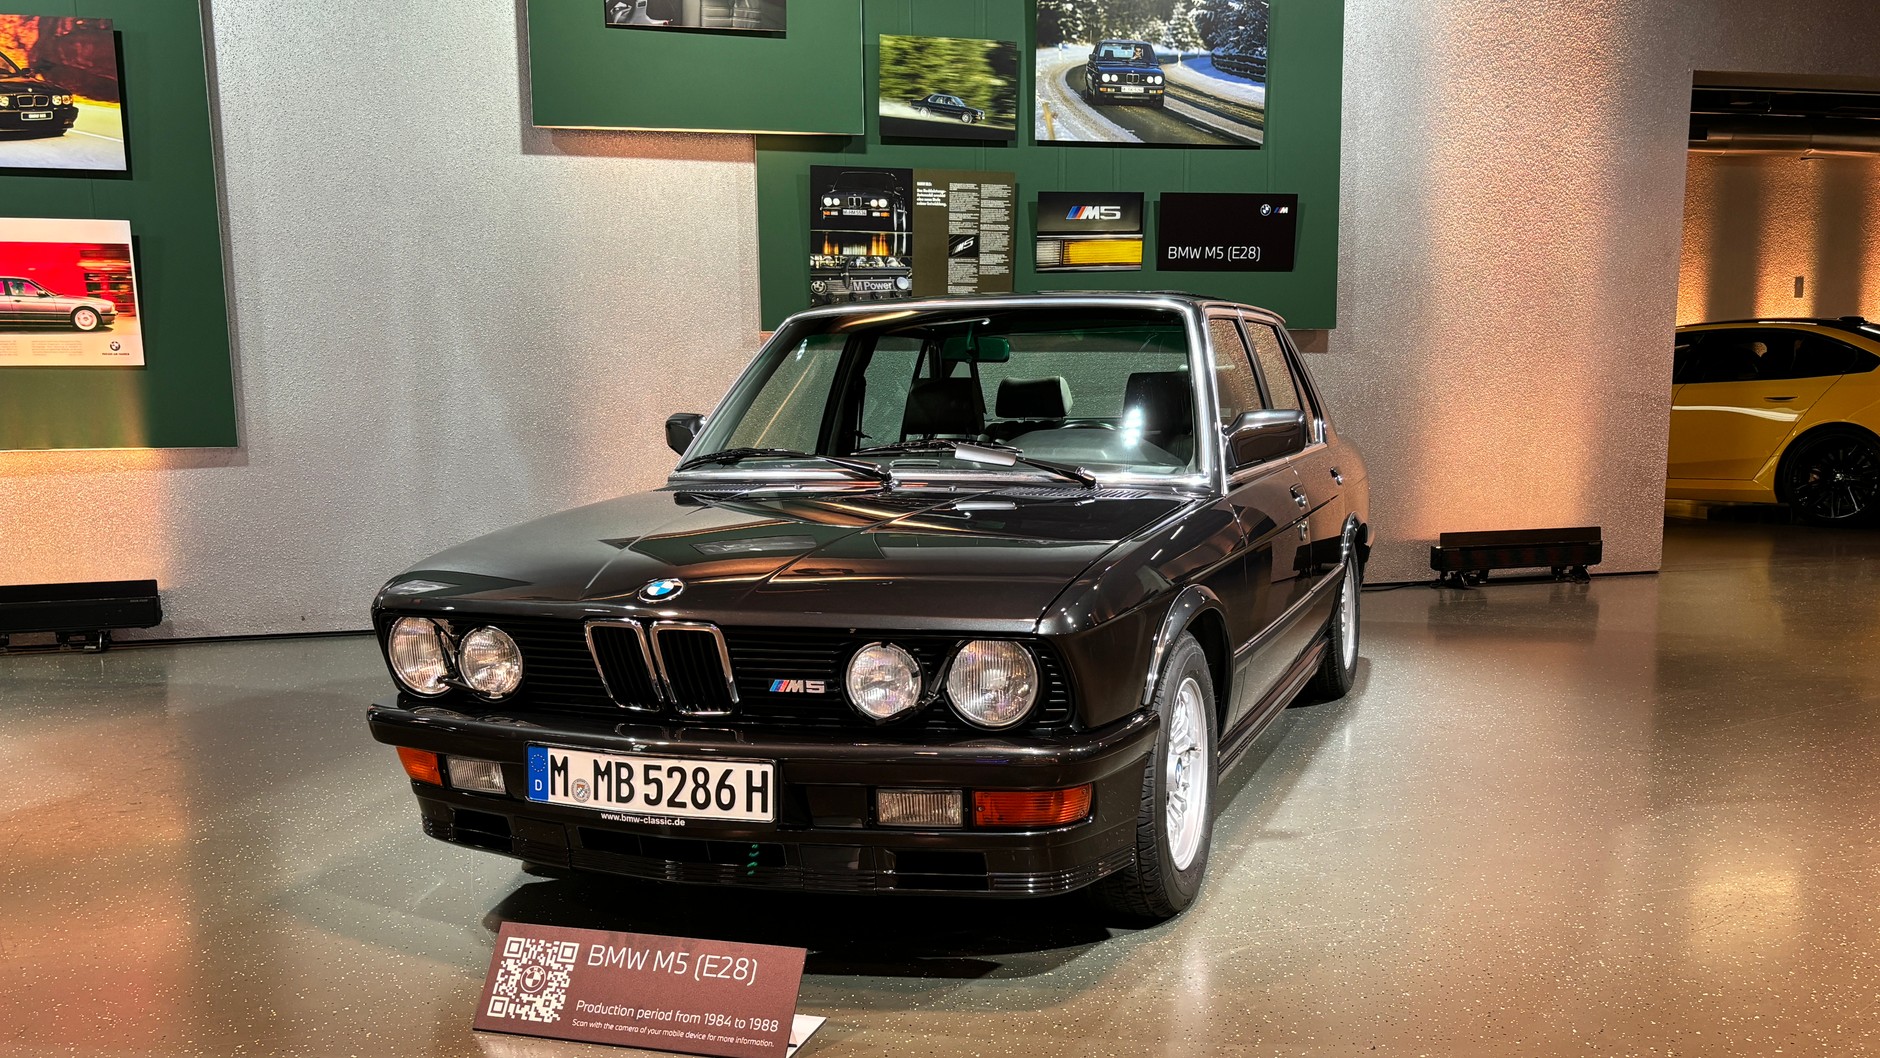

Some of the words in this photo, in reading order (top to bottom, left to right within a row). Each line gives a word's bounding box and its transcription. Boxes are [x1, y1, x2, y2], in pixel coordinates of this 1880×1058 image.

[1080, 205, 1121, 220] M5
[1168, 246, 1202, 259] BMW
[1204, 246, 1224, 259] M5
[1227, 246, 1261, 262] (E28)
[852, 281, 863, 291] M
[864, 281, 893, 291] Power
[785, 679, 825, 694] M5
[534, 779, 543, 791] D
[550, 754, 569, 797] M
[593, 758, 635, 804] MB
[643, 763, 736, 811] 5286
[746, 769, 768, 813] H
[600, 812, 686, 827] www.bmw-classic.de
[587, 944, 650, 970] BMW
[652, 950, 690, 975] M5
[694, 953, 758, 986] (E28)
[575, 999, 635, 1017] Production
[636, 1008, 673, 1021] period
[674, 1010, 701, 1025] from
[704, 1013, 732, 1027] 1984
[734, 1017, 746, 1029] to
[749, 1017, 779, 1033] 1988
[572, 1018, 588, 1027] Scan
[589, 1021, 602, 1029] with
[603, 1022, 614, 1030] the
[615, 1024, 639, 1033] camera
[640, 1026, 648, 1034] of
[647, 1027, 661, 1036] your
[662, 1029, 684, 1038] mobile
[685, 1031, 706, 1040] device
[706, 1033, 717, 1041] for
[717, 1036, 734, 1044] more
[735, 1036, 775, 1048] information.
